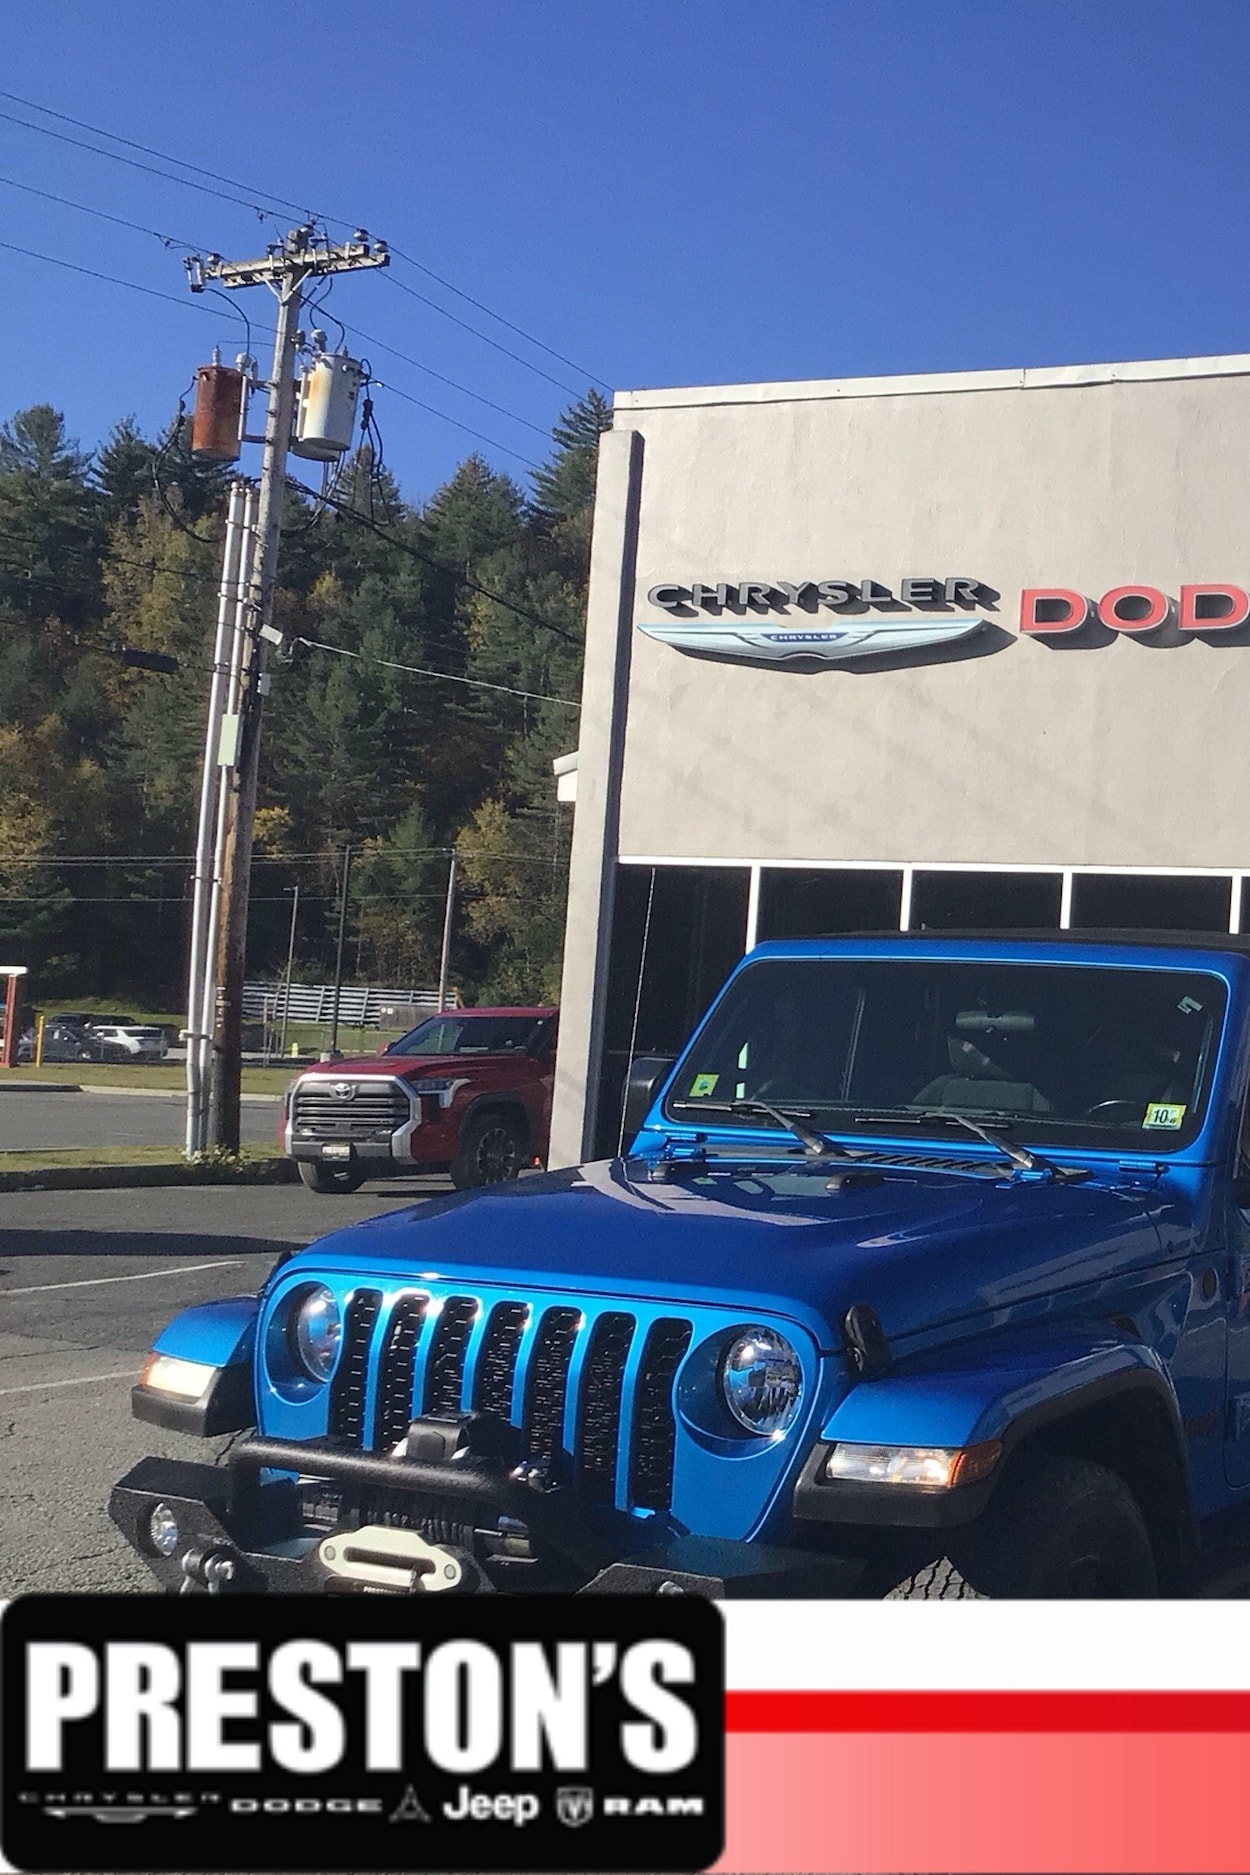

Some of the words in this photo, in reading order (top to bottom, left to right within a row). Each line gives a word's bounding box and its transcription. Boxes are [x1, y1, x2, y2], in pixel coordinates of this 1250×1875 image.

[648, 577, 982, 607] CHRYSLER
[770, 633, 837, 641] CHRYSLER
[1154, 1109, 1169, 1124] 10
